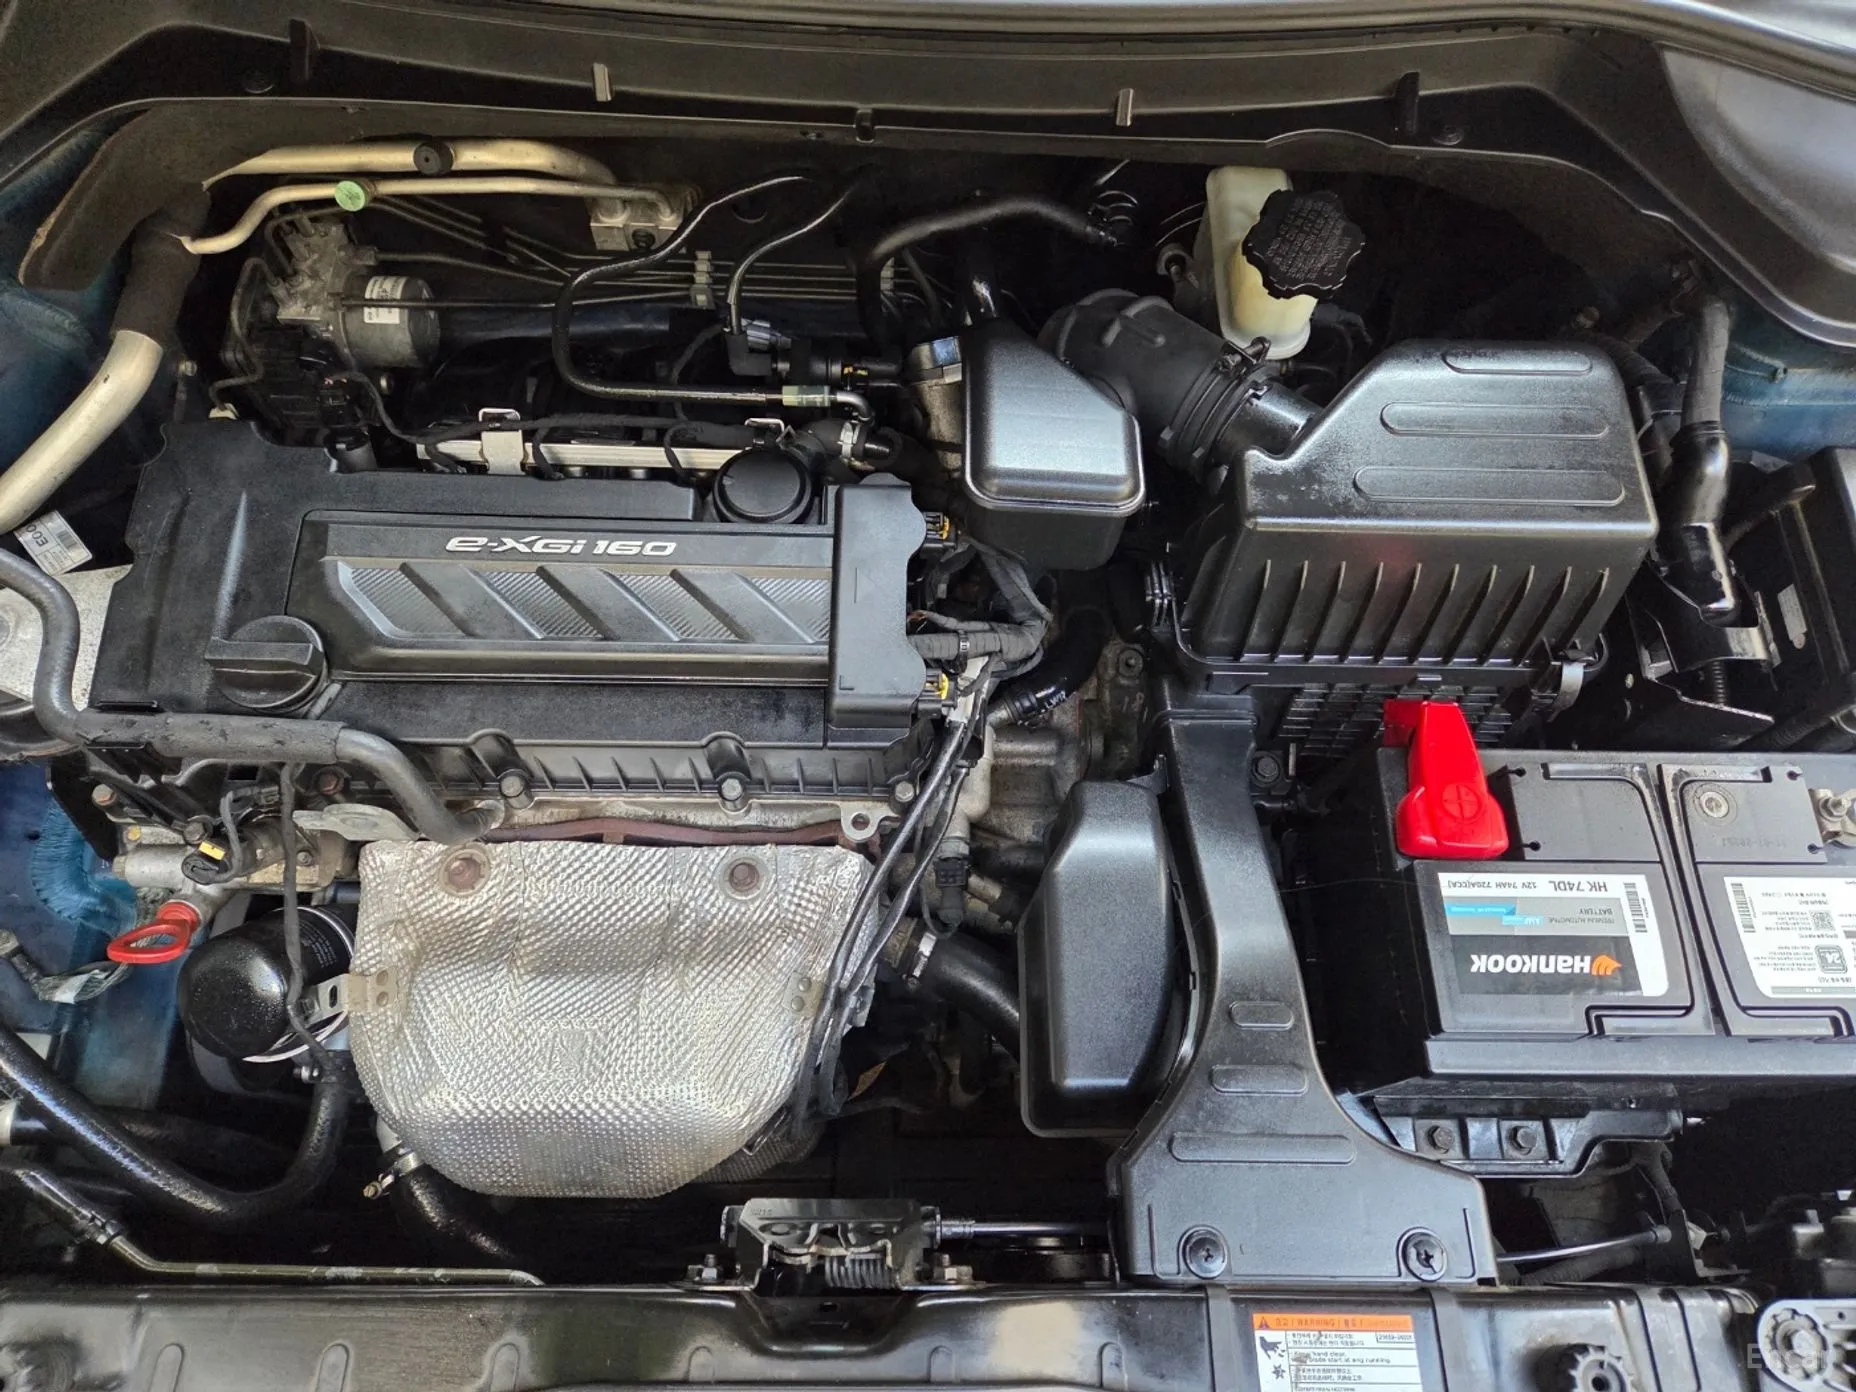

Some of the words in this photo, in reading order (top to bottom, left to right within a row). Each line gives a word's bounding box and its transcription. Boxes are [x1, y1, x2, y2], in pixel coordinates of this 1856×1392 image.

[592, 540, 678, 557] 160
[1495, 881, 1517, 889] 74AH
[1521, 881, 1537, 889] 12V
[1548, 880, 1585, 892] 74DL
[1589, 881, 1608, 893] HK
[1579, 907, 1613, 915] BATTERY
[1297, 1318, 1336, 1328] WARNING
